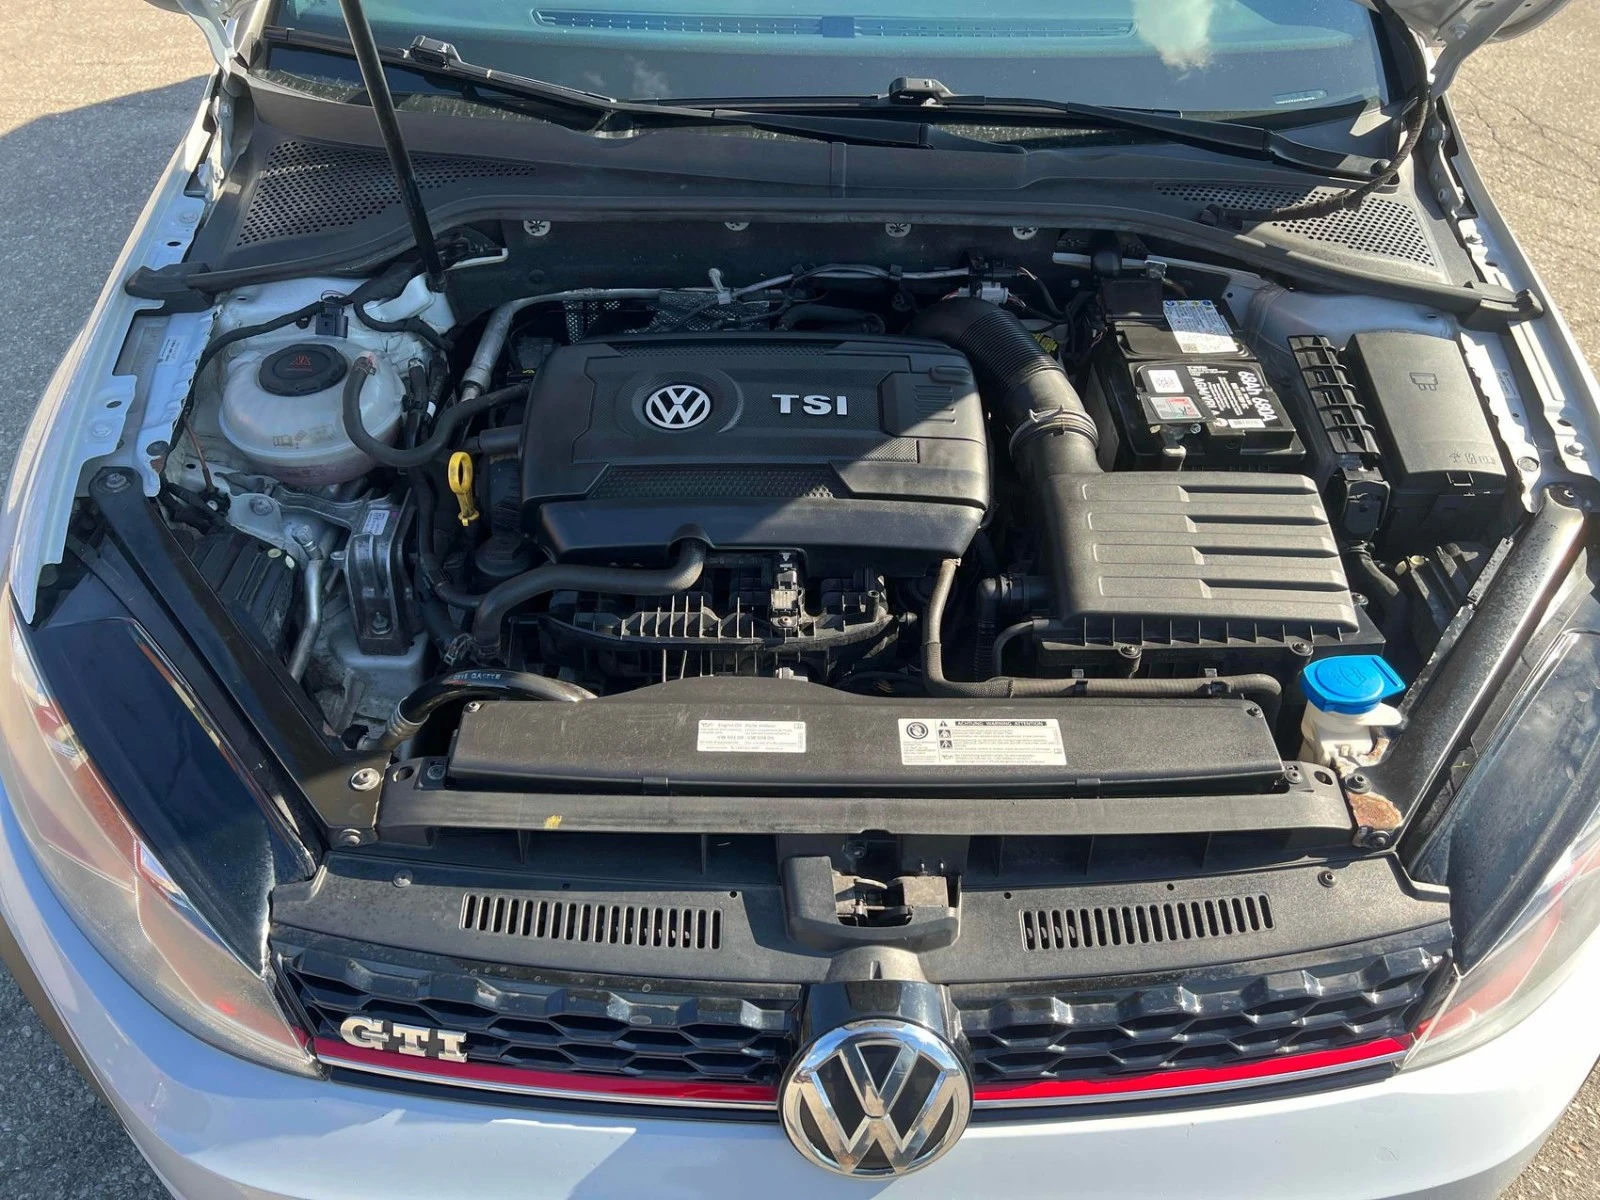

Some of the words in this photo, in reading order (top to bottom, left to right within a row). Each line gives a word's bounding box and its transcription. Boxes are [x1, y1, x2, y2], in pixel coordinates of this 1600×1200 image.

[772, 394, 848, 415] TSI
[1238, 371, 1263, 395] 68Ah
[1252, 397, 1278, 422] 680A
[340, 1016, 468, 1063] GTI
